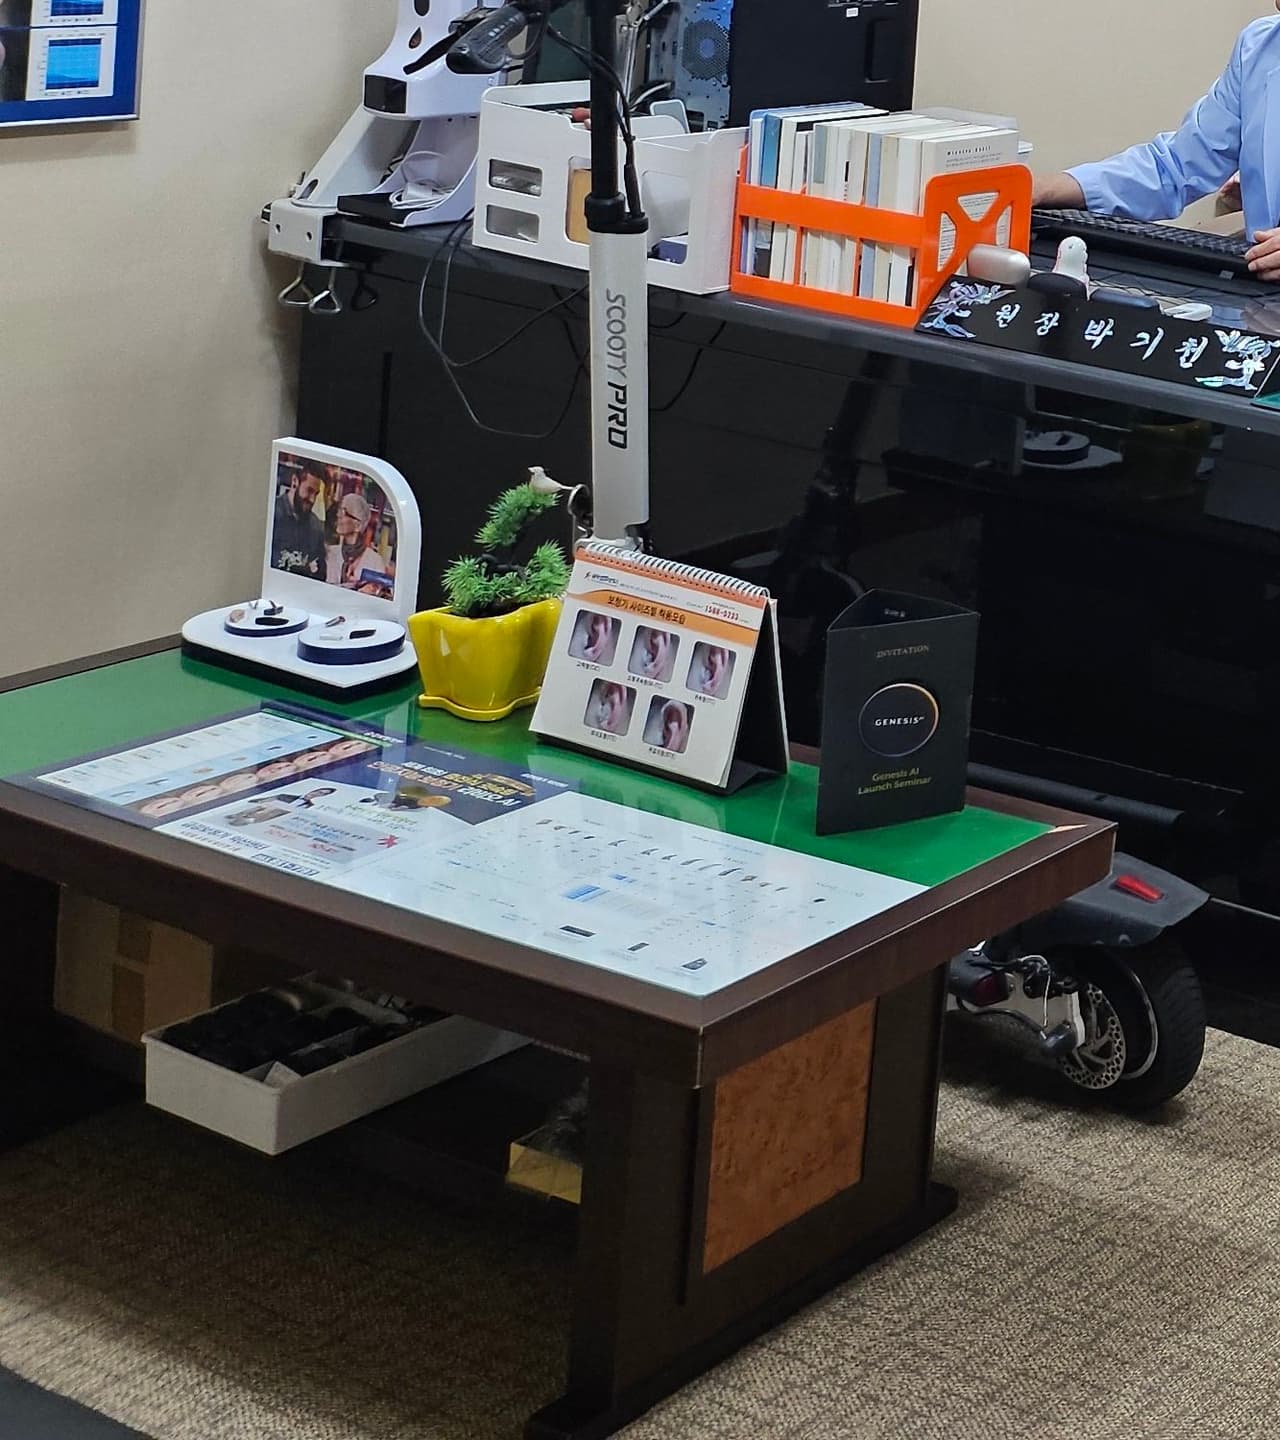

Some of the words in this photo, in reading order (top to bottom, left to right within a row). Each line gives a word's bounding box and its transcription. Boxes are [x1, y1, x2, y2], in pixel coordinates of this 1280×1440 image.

[606, 288, 627, 379] SCOOTY
[608, 381, 628, 450] PRO
[876, 644, 930, 658] INVITATION
[875, 716, 919, 727] GENESIS
[872, 768, 907, 782] Genesis
[908, 767, 920, 777] AI
[858, 782, 893, 795] Launch
[894, 776, 932, 789] Seminar
